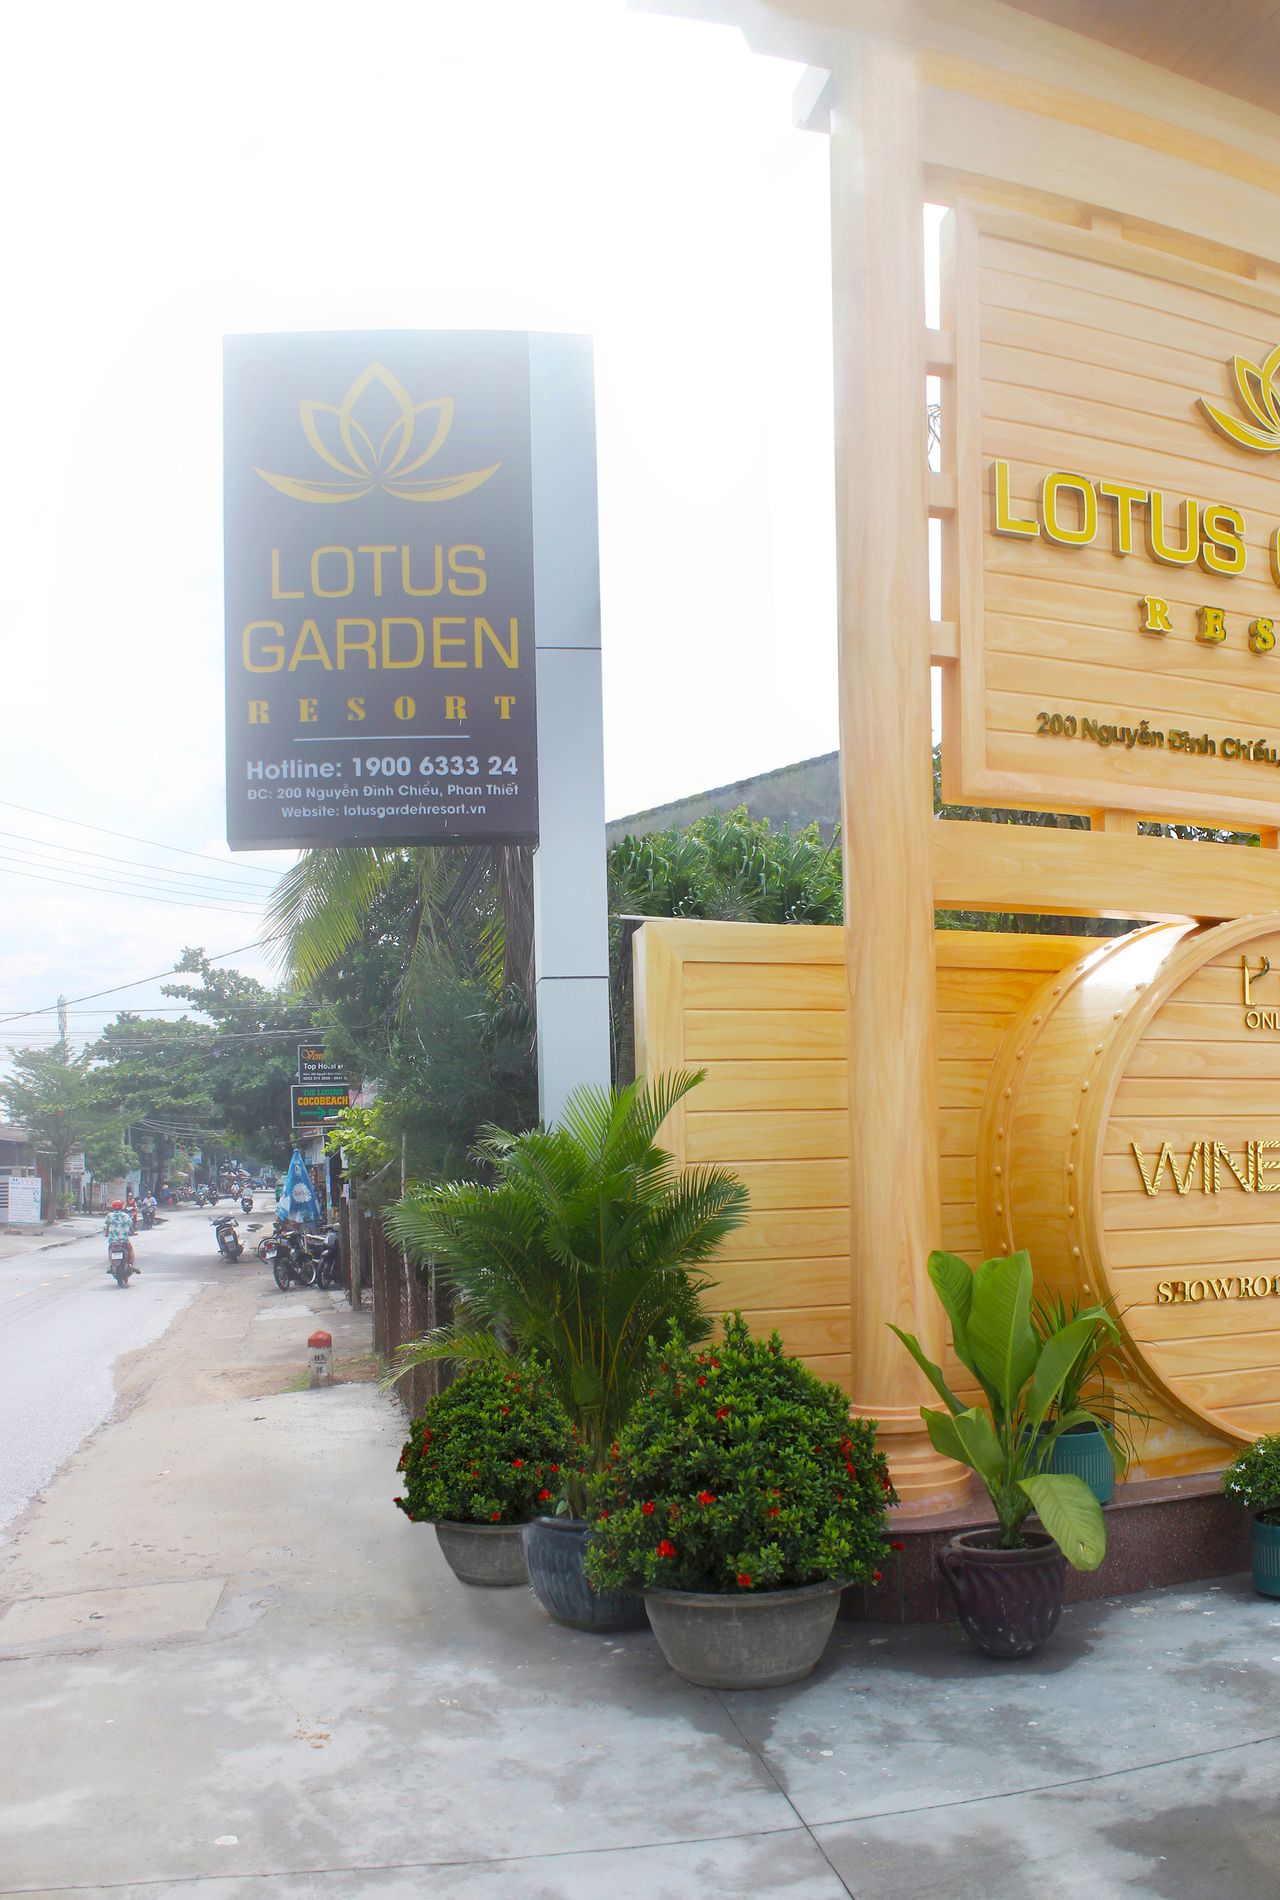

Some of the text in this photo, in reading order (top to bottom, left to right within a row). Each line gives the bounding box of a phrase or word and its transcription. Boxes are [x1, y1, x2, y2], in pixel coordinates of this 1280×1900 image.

[990, 460, 1247, 577] LOTUS
[271, 544, 487, 599] LOTUS
[242, 617, 519, 672] GARDEN
[247, 695, 517, 724] RESORT
[1036, 712, 1078, 736] 200
[1081, 720, 1164, 749] Nguyễn
[247, 756, 518, 780] Hotline: 1900 6333 24
[247, 788, 273, 800] ĐC:
[277, 787, 302, 799] 200
[306, 783, 359, 801] Nguyễn
[363, 784, 394, 797] Đình
[447, 784, 482, 796] Phan
[486, 782, 519, 796] Thiết
[281, 803, 486, 819] Website: lotusgardenresort.vn
[297, 1096, 349, 1106] COCOBEACH
